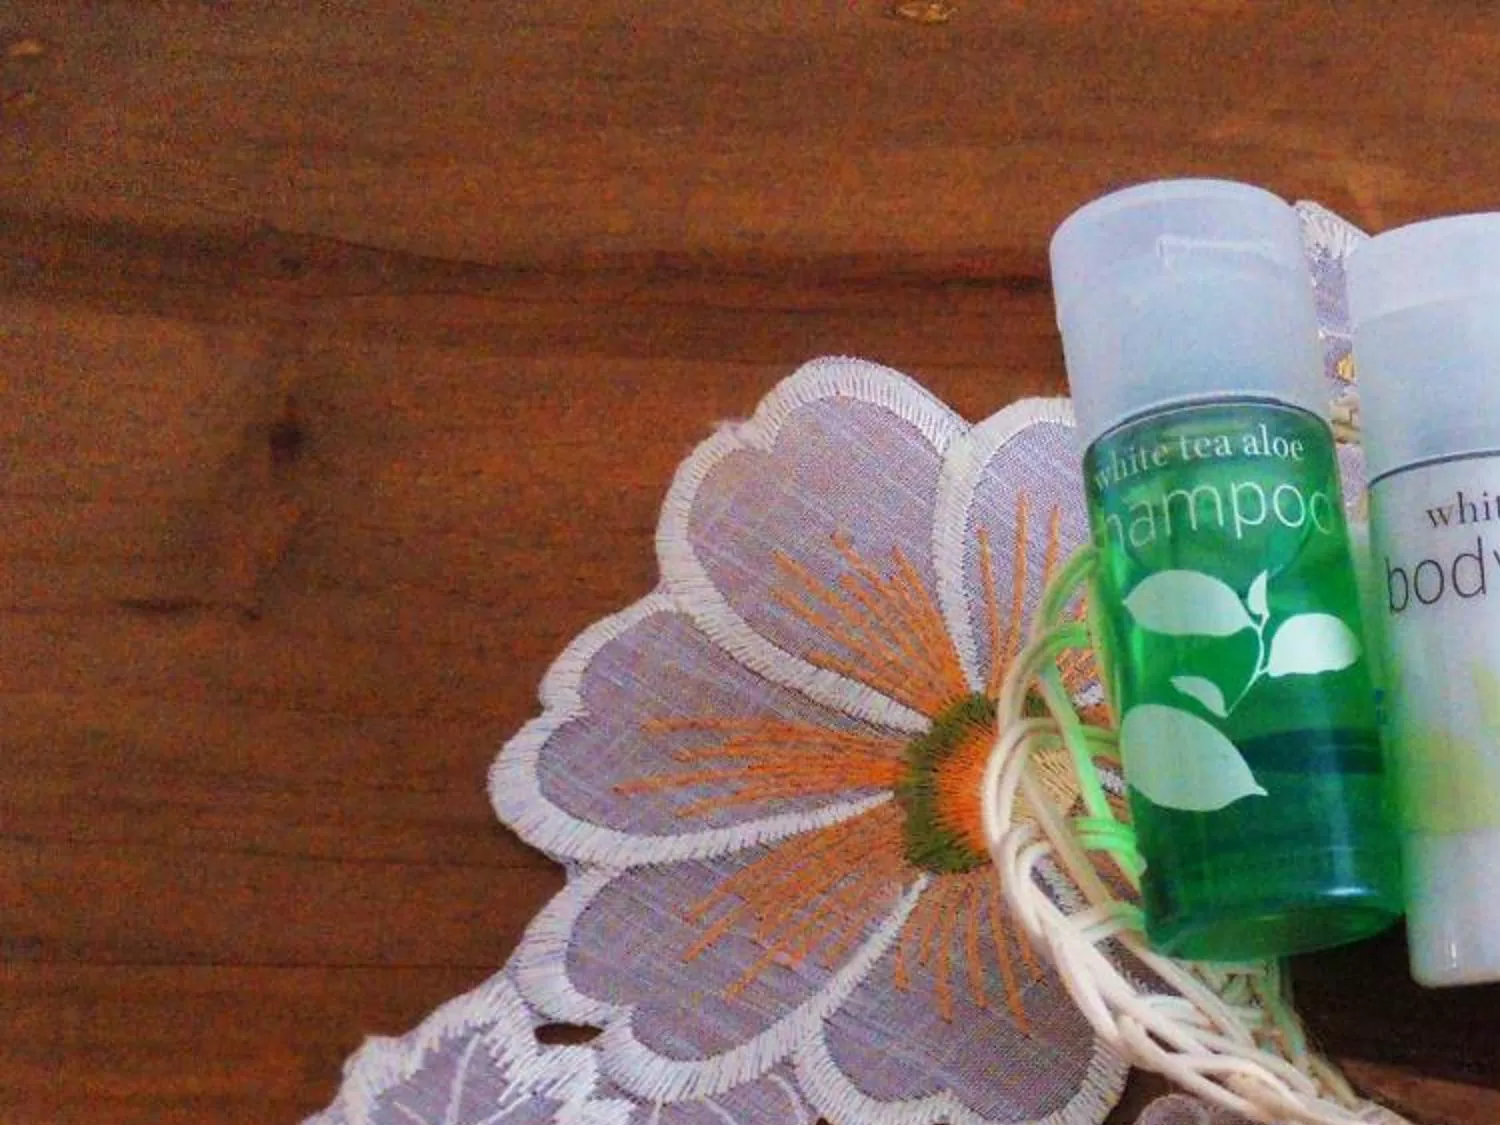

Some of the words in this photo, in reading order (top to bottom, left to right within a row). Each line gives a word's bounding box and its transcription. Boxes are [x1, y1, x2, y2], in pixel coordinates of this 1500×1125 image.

[1094, 446, 1169, 491] white
[1179, 434, 1232, 462] tea
[1241, 423, 1304, 460] aloe
